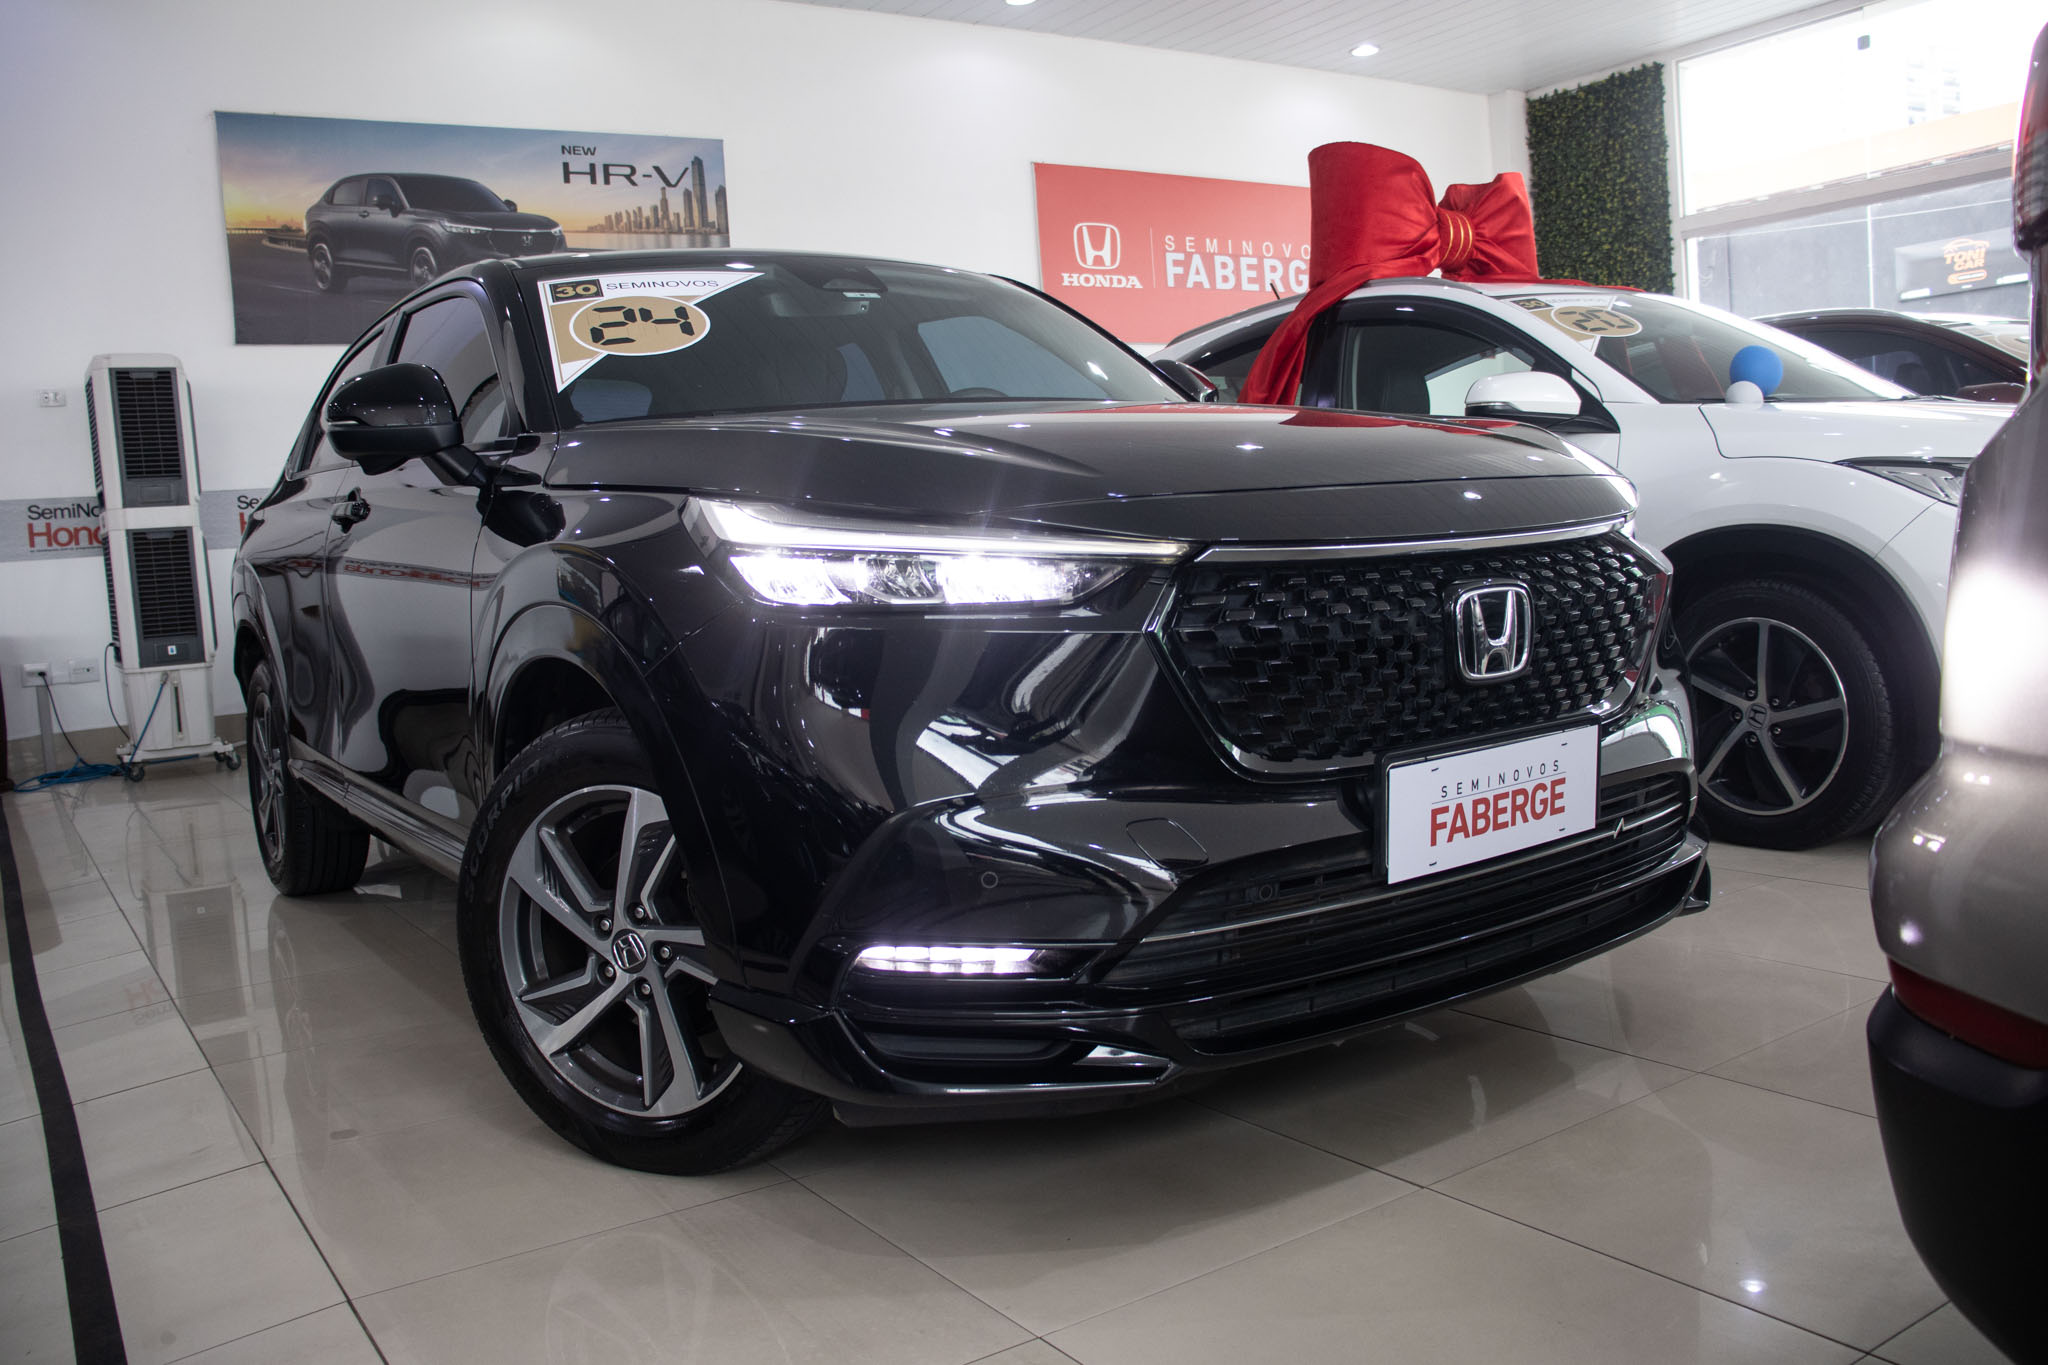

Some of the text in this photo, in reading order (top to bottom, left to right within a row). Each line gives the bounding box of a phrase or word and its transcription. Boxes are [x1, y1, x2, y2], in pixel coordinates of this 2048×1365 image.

[561, 145, 596, 156] NEW
[563, 162, 686, 188] HR-V
[1165, 235, 1311, 260] SEMINOVO
[1943, 247, 1986, 265] TONI
[1165, 252, 1310, 293] FABERG
[1953, 258, 1986, 271] CAR
[555, 280, 719, 298] 30 SEMINOVOS
[1062, 272, 1143, 288] HONDA
[589, 305, 695, 346] 24
[28, 503, 100, 520] SemiNo
[28, 522, 103, 547] Hon
[1441, 759, 1559, 798] SEMINOVOS
[1430, 777, 1567, 847] FABERGE
